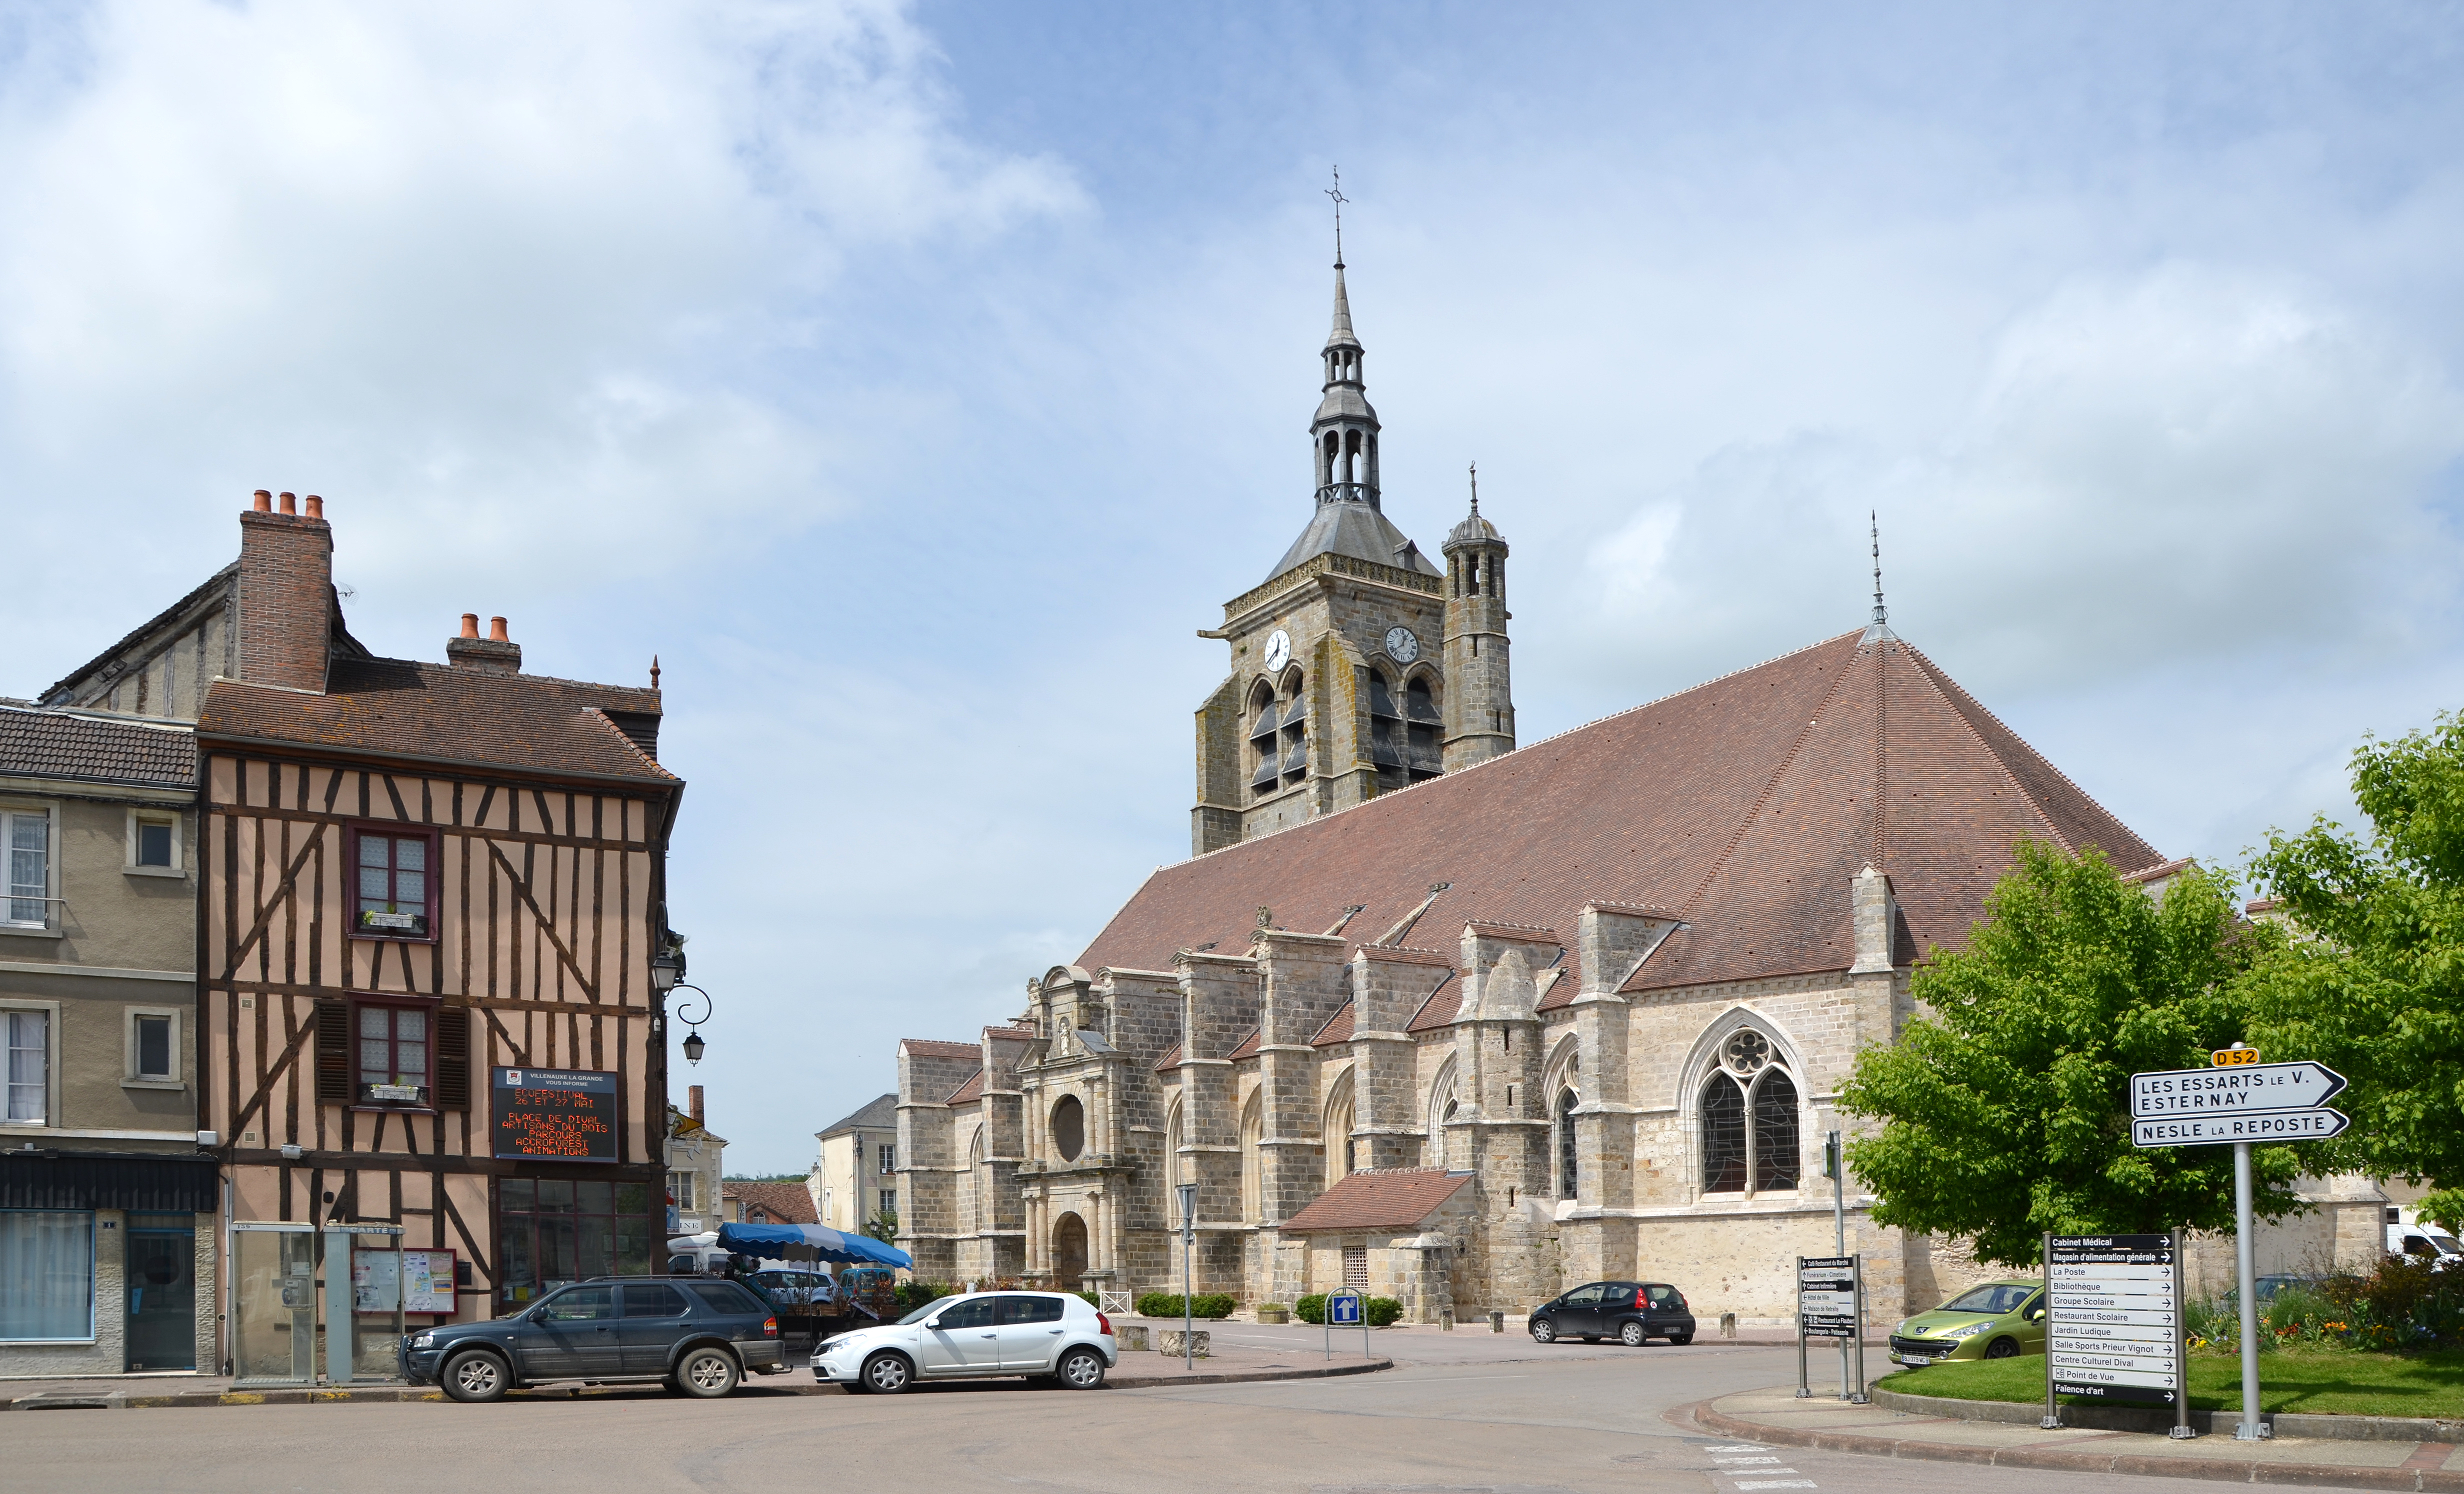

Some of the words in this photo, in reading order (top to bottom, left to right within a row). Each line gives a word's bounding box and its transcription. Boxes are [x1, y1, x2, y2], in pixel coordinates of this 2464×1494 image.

[2217, 1052, 2227, 1065] D
[2232, 1050, 2256, 1064] 52
[2142, 1080, 2173, 1094] LES
[2182, 1074, 2264, 1092] ESSARTS
[2270, 1076, 2284, 1086] LE
[2292, 1071, 2309, 1084] V.
[516, 1096, 528, 1105] 26
[535, 1098, 548, 1106] ET
[554, 1098, 568, 1107] 27
[574, 1099, 594, 1108] MAI
[2142, 1092, 2248, 1110] ESTERNAY
[508, 1112, 542, 1122] PLACE
[548, 1114, 562, 1123] DE
[568, 1115, 600, 1124] DIVAL
[502, 1120, 555, 1130] ARTISANS
[562, 1122, 575, 1132] DU
[581, 1124, 608, 1133] BOIS
[2143, 1124, 2202, 1140] NESLE
[2212, 1127, 2224, 1136] LA
[2234, 1117, 2325, 1134] REPOSTE
[529, 1130, 582, 1140] PARCOURS
[516, 1138, 588, 1148] ACCROFOREST
[522, 1146, 589, 1156] ANIMATIONS
[2052, 1238, 2081, 1246] Cabinet
[2082, 1238, 2112, 1246] Médical
[2053, 1253, 2078, 1262] Magasin
[2080, 1253, 2125, 1261] d'alimentation
[2126, 1252, 2156, 1263] générale
[2054, 1282, 2100, 1292] Bibliothèque
[2054, 1297, 2082, 1306] Groupe
[2084, 1298, 2115, 1306] Scolaire
[2054, 1312, 2094, 1320] Restaurant
[2096, 1312, 2128, 1322] Scolaire
[2055, 1326, 2078, 1334] Jardin
[2080, 1327, 2111, 1336] Ludique
[2055, 1340, 2074, 1348] Salle
[2075, 1342, 2100, 1350] Sports
[2102, 1343, 2126, 1351] Prieur
[2128, 1344, 2154, 1354] Vignot
[2055, 1355, 2080, 1364] Centre
[2082, 1356, 2112, 1366] Culturel
[2114, 1358, 2134, 1367] Dival
[2066, 1370, 2086, 1379] Point
[2088, 1372, 2098, 1380] de
[2100, 1373, 2114, 1381] Vue
[2056, 1384, 2084, 1394] Faïence
[2086, 1386, 2104, 1396] d'art
